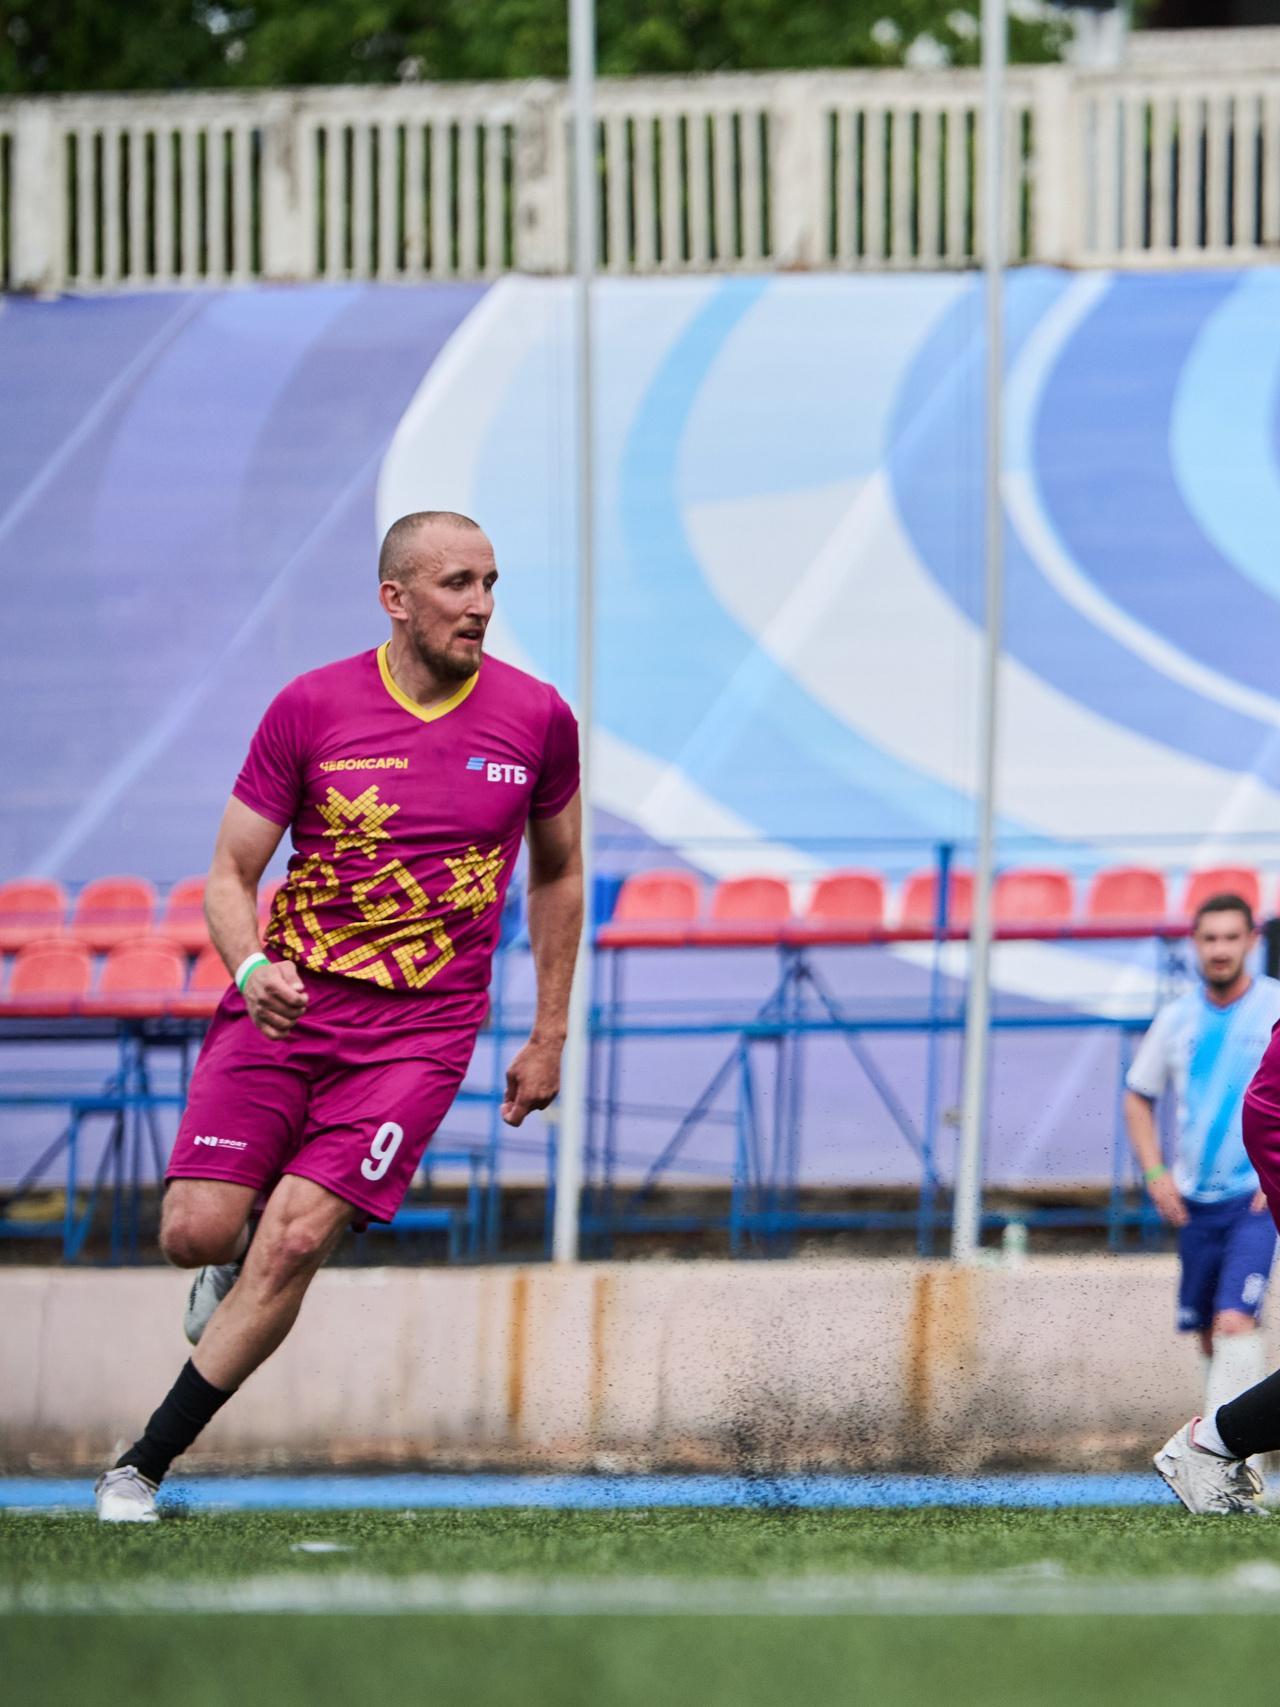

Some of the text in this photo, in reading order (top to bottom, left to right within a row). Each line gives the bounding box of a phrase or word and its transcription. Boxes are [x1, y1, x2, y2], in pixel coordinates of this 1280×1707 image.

[319, 757, 409, 773] ЧЕБОКСАРЫ
[487, 762, 528, 785] ВТБ
[360, 1121, 404, 1182] 9
